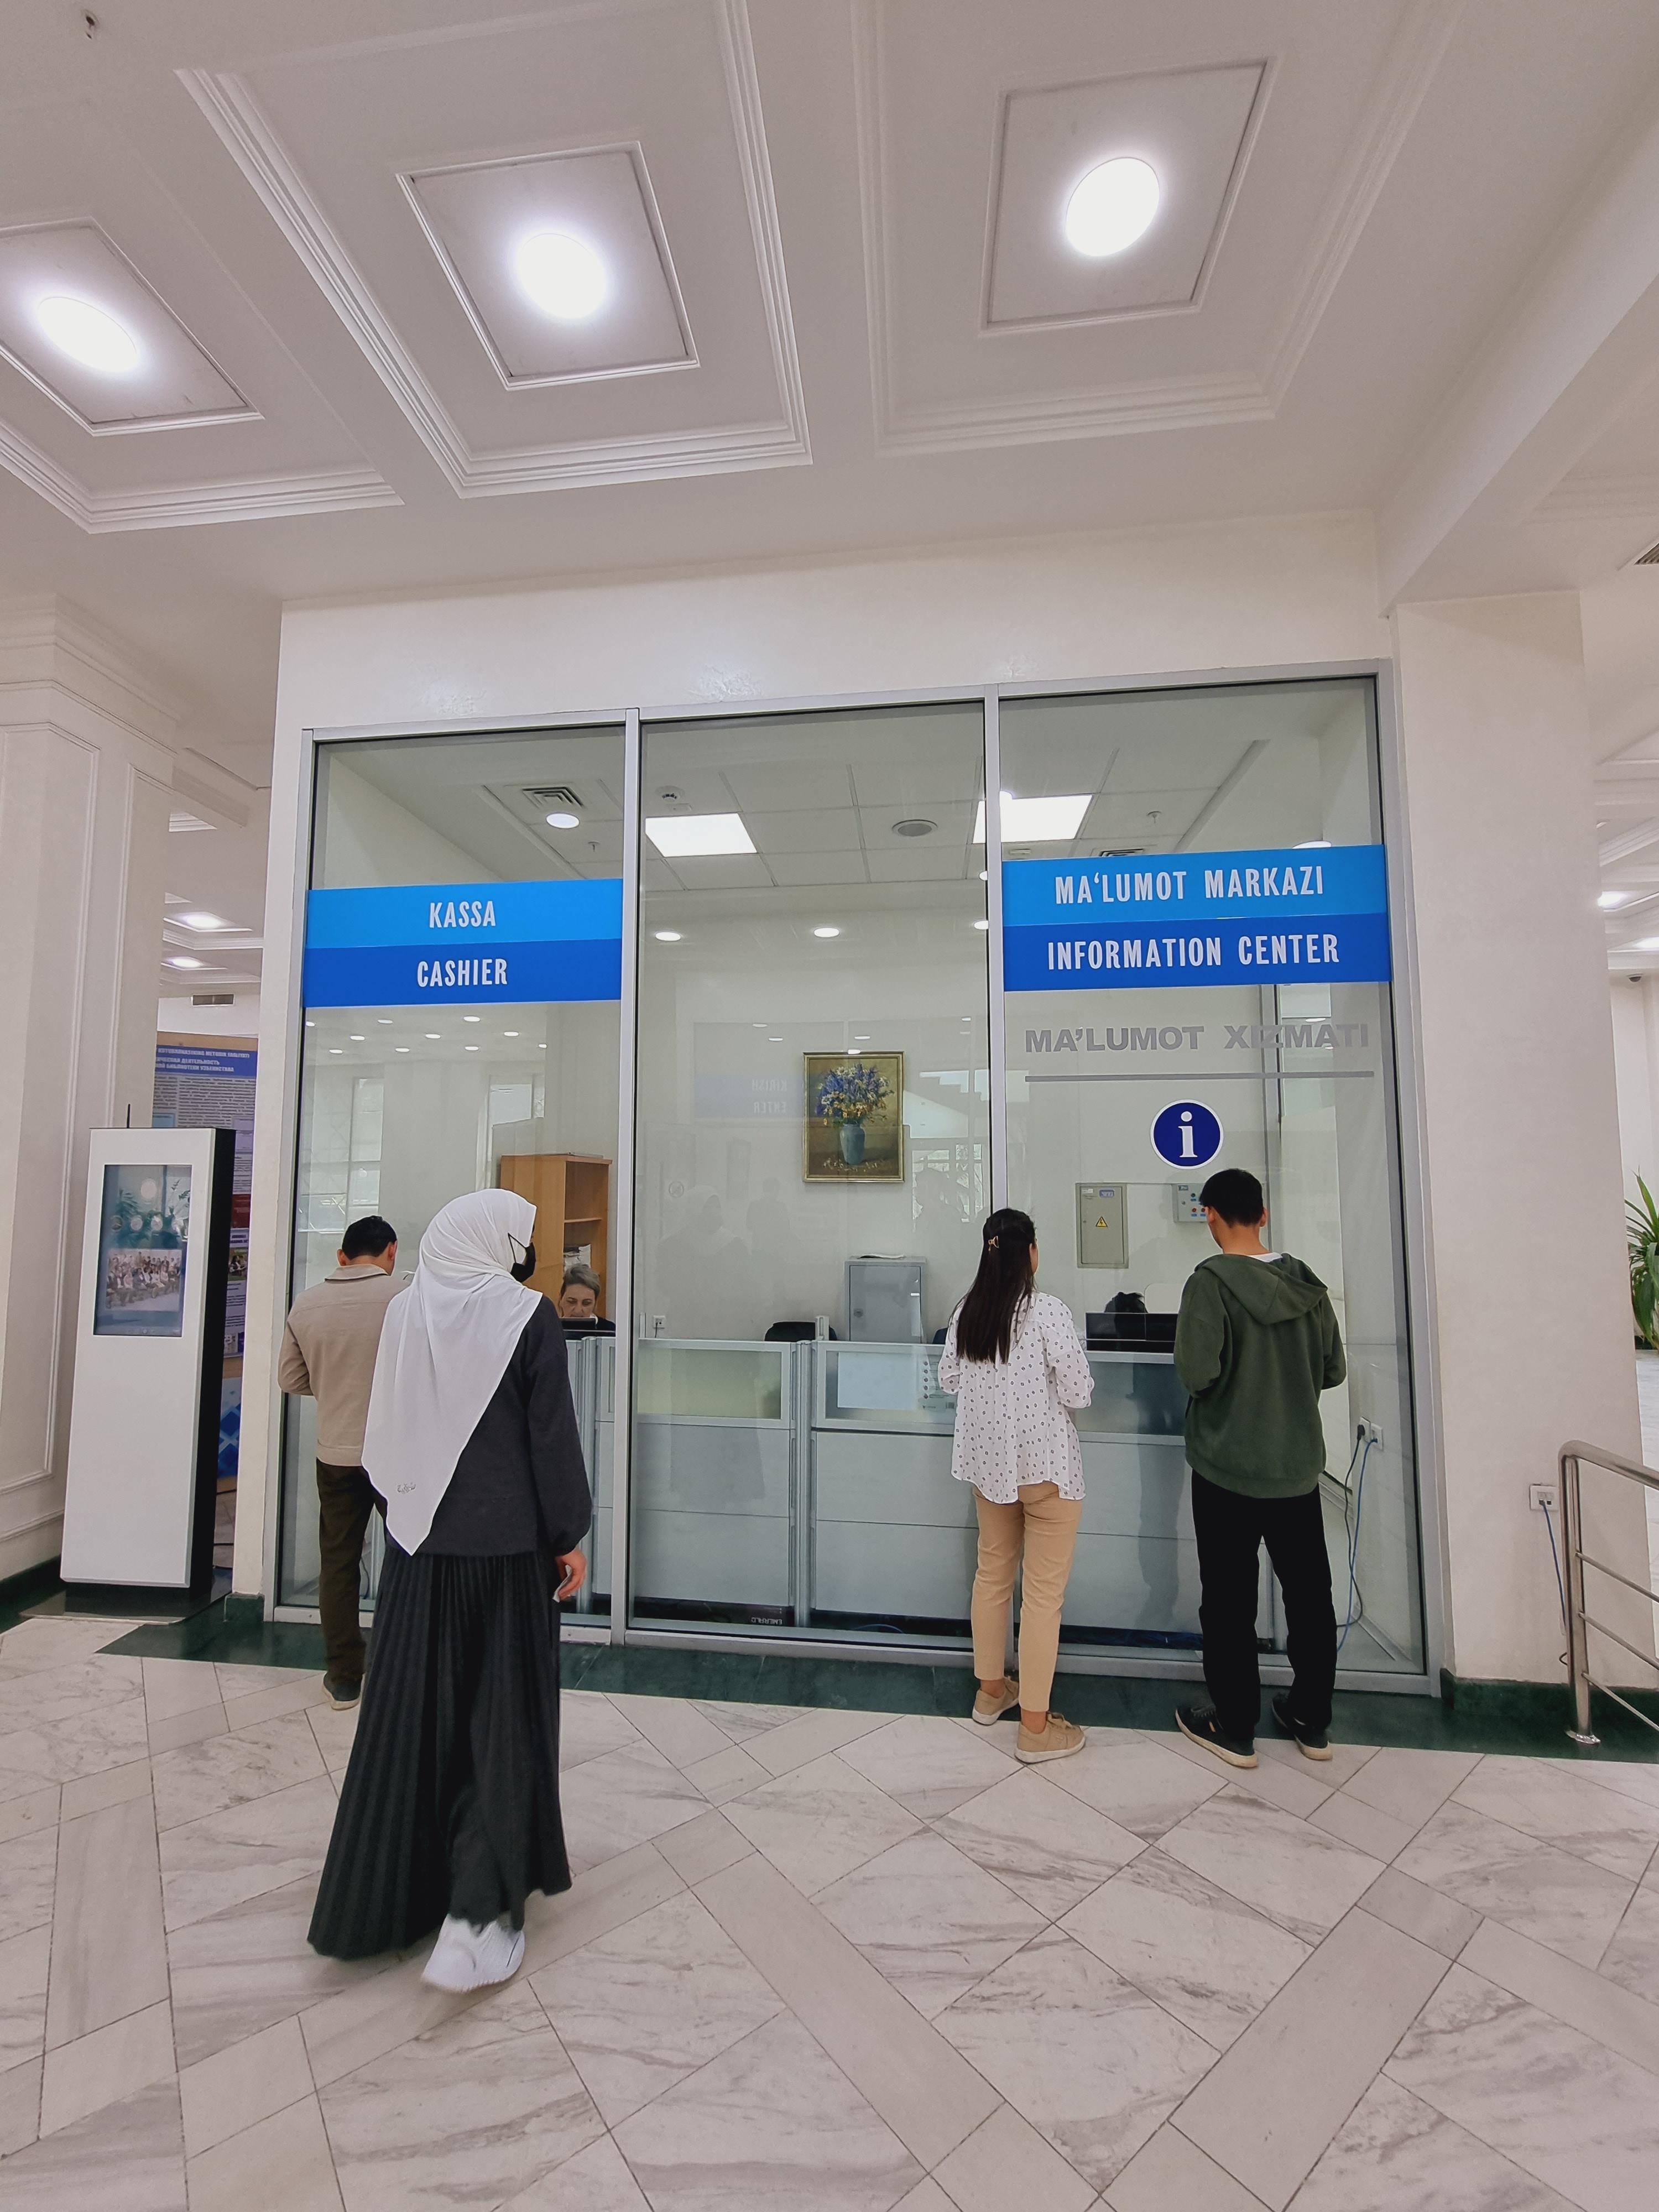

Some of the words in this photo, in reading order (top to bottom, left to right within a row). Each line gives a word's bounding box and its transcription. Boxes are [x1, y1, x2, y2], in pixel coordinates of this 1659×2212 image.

[1204, 865, 1324, 899] MARKAZI
[429, 900, 496, 928] KASSA
[1048, 937, 1222, 970] INFORMATION
[1238, 933, 1340, 966] CENTER
[417, 958, 508, 988] CASHIER
[1223, 1023, 1369, 1050] XIZMATI
